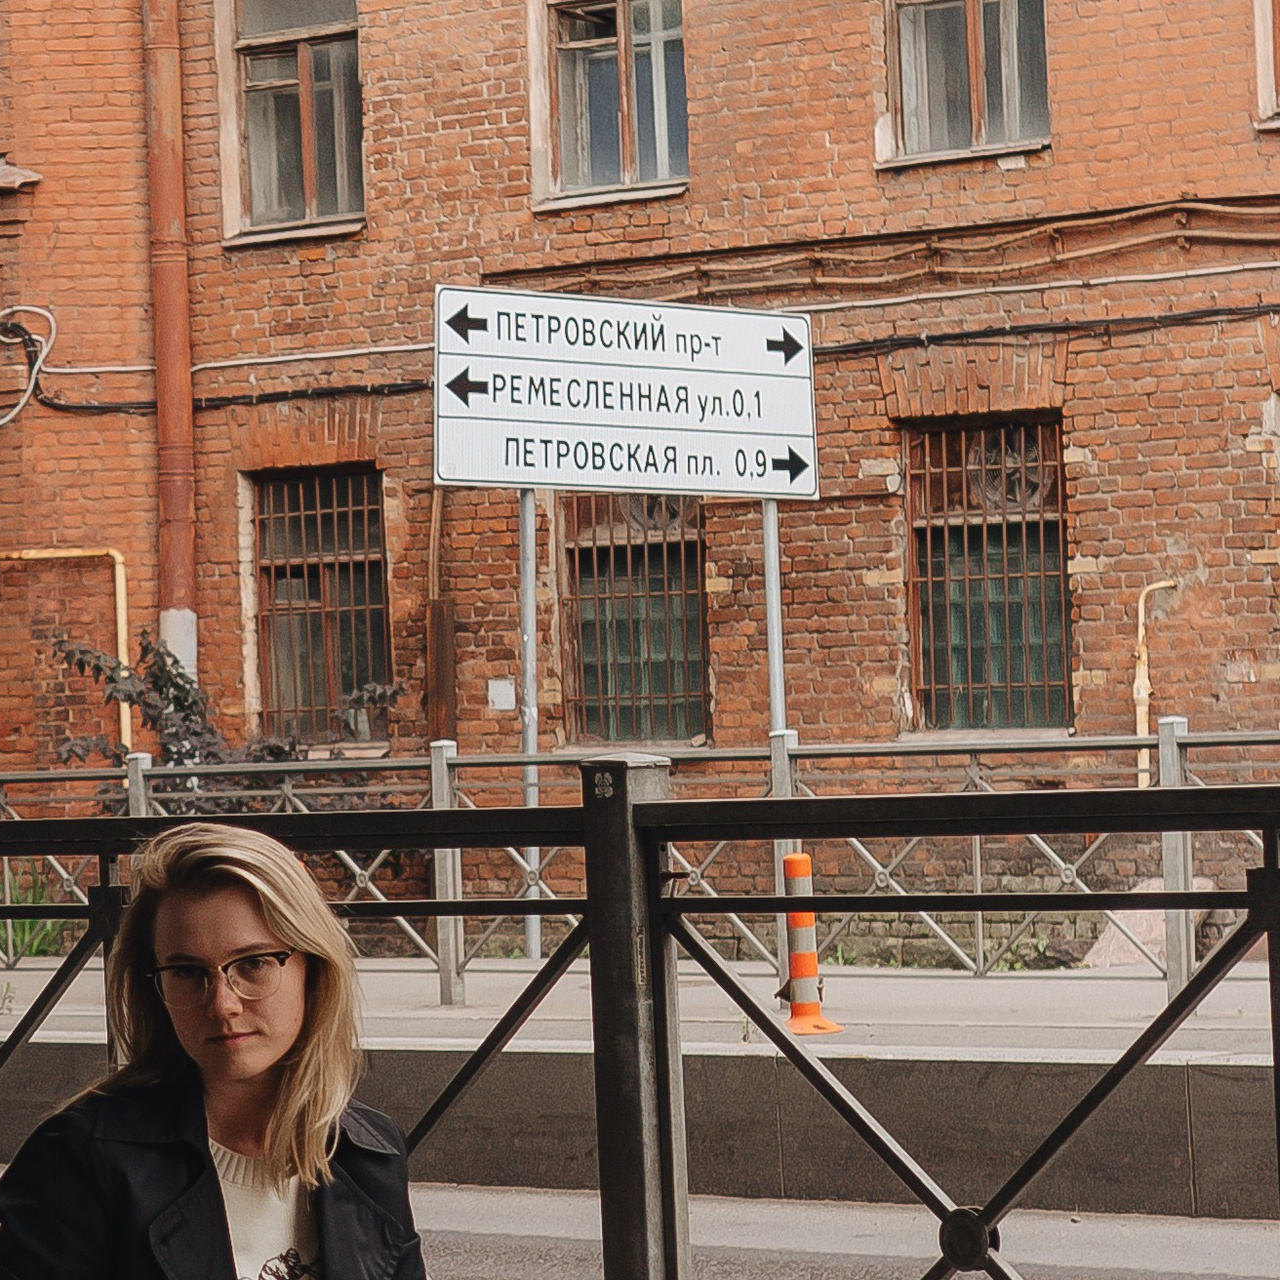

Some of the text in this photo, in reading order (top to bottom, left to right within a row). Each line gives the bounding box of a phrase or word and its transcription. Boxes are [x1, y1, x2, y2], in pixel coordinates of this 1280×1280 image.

[496, 311, 722, 362] ПЕТРОВСКИЙ пр-т
[492, 373, 689, 414] РЕМЕСЛЕННАЯ
[505, 437, 767, 482] ПЕТРОВСКАЯ пл. 0,9
